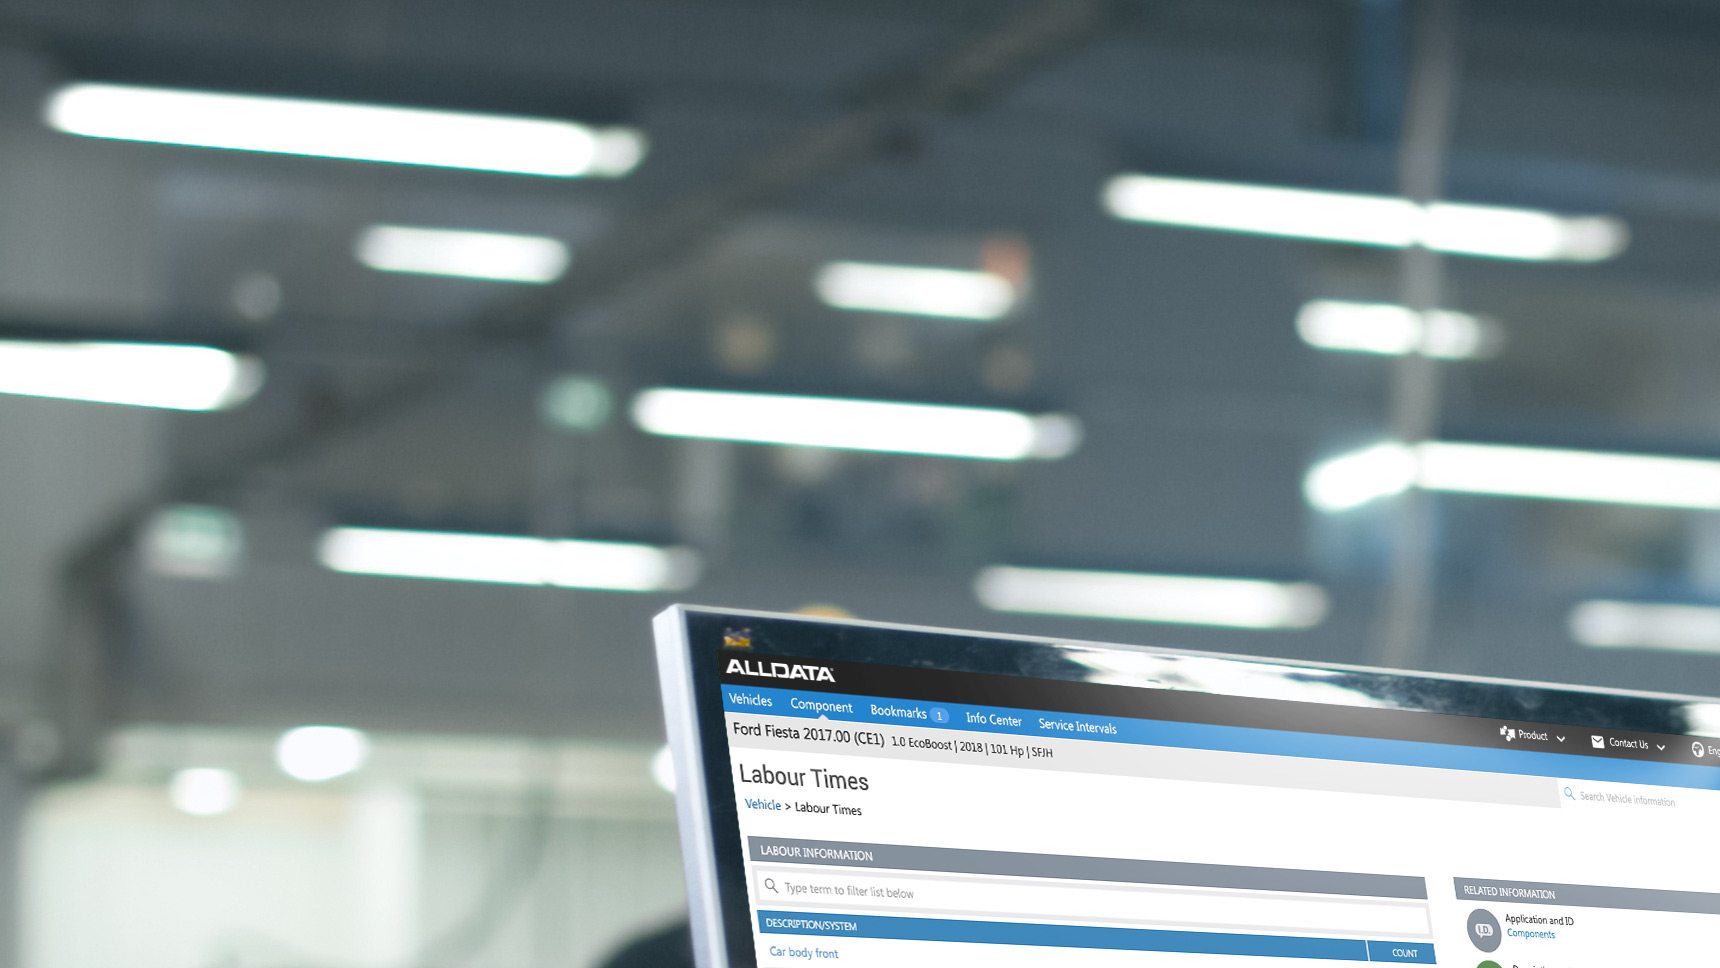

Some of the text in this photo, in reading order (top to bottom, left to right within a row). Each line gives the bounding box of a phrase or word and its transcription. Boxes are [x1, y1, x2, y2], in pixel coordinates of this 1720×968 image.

[725, 659, 836, 682] ALLDATA
[728, 692, 773, 707] Vehicles
[790, 697, 853, 713] Component
[870, 705, 927, 719] Bookmarks
[966, 712, 1022, 727] Info Center
[1038, 718, 1118, 735] Service Intervals
[733, 722, 761, 736] Ford
[765, 724, 800, 739] Fiesta
[803, 727, 850, 743] 2017.00
[854, 731, 885, 748] (CE1)
[891, 735, 905, 747] 1.0
[908, 737, 952, 750] EcoBoost
[960, 741, 983, 753] 2018
[990, 743, 1008, 755] 101
[1010, 745, 1024, 758] Hp
[1518, 729, 1548, 741] Product
[1609, 738, 1649, 749] Contact Us
[739, 763, 869, 791] Labour Times
[1580, 791, 1676, 807] Search Vehicle information
[744, 798, 781, 810] Vehicle
[795, 801, 830, 814] Labour
[832, 804, 862, 816] Times
[760, 845, 873, 862] LABOUR INFORMATION
[784, 882, 914, 899] Type term to filter list below
[1463, 885, 1556, 900] RELATED INFORMATION
[765, 918, 858, 931] DESCRIPTION/SYSTEM
[1505, 914, 1574, 926] Application and ID
[1507, 928, 1556, 939] Components
[769, 946, 839, 960] Car body front
[1392, 948, 1418, 958] COUNT
